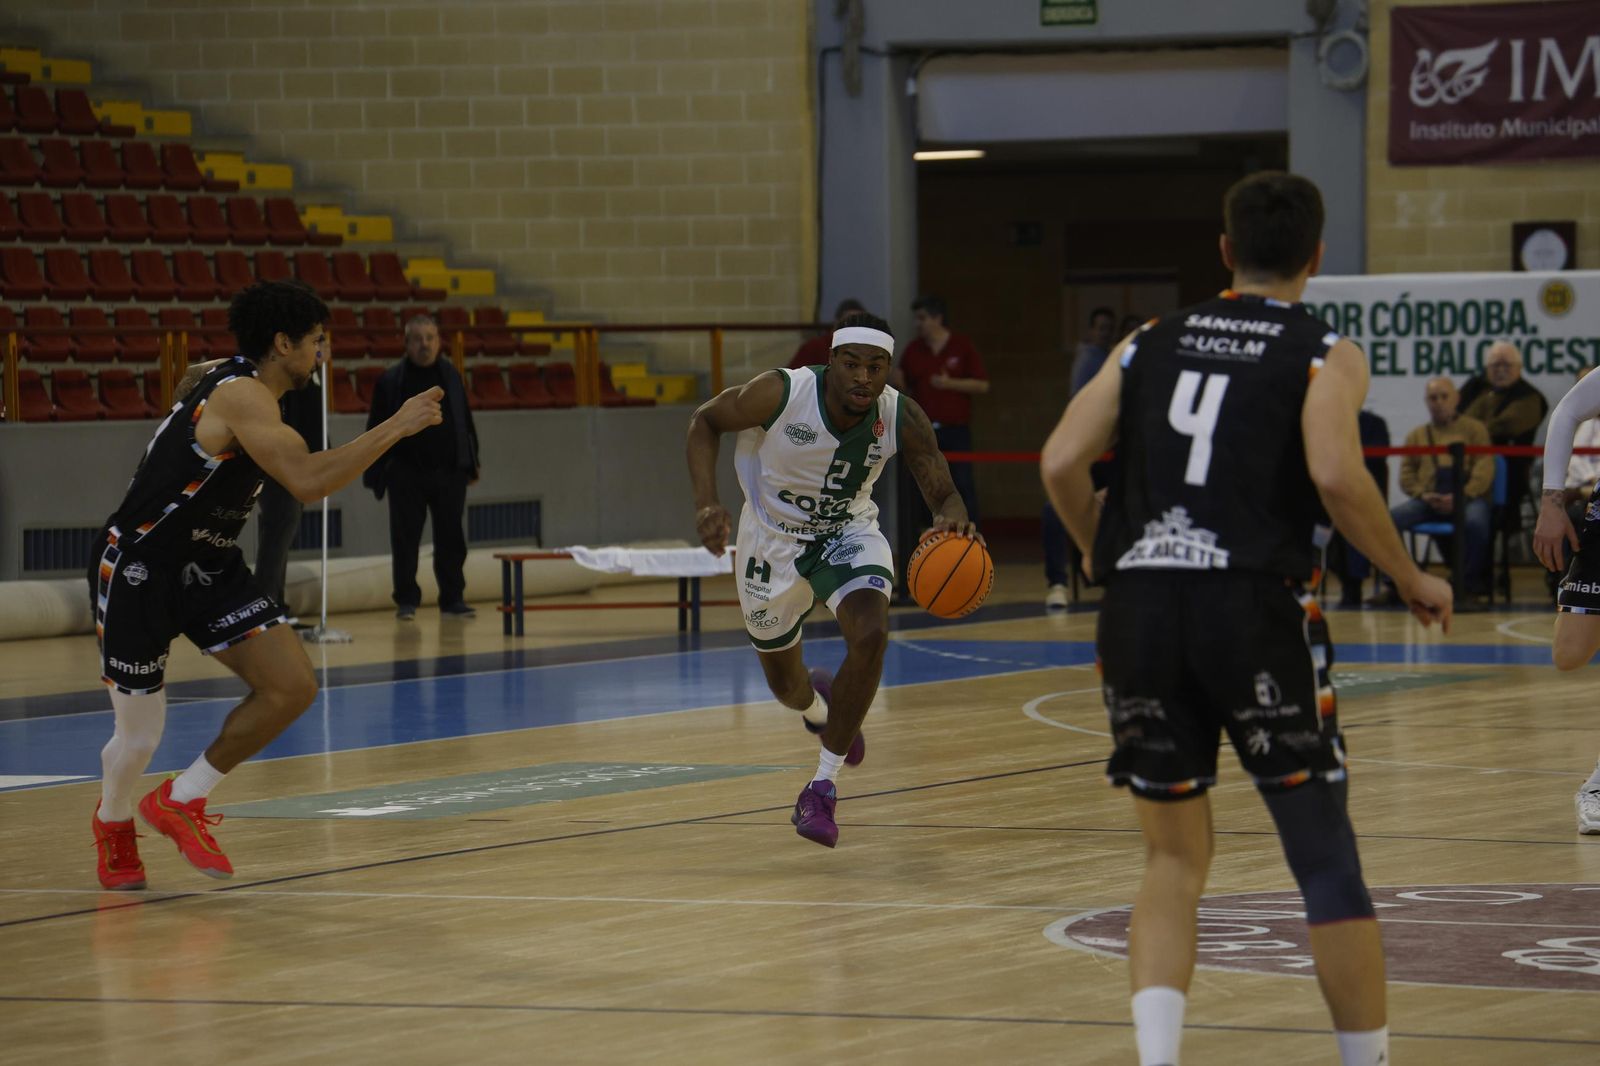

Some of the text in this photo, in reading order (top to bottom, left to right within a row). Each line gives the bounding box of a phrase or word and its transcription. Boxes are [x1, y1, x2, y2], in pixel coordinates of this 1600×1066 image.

[1409, 120, 1496, 140] Instituto
[1370, 292, 1537, 337] CÓRDOBA.
[1195, 334, 1266, 358] UCLM
[1371, 338, 1600, 376] EL BALCEST
[1168, 369, 1230, 487] 4
[826, 459, 851, 490] 2
[108, 656, 158, 675] amiab
